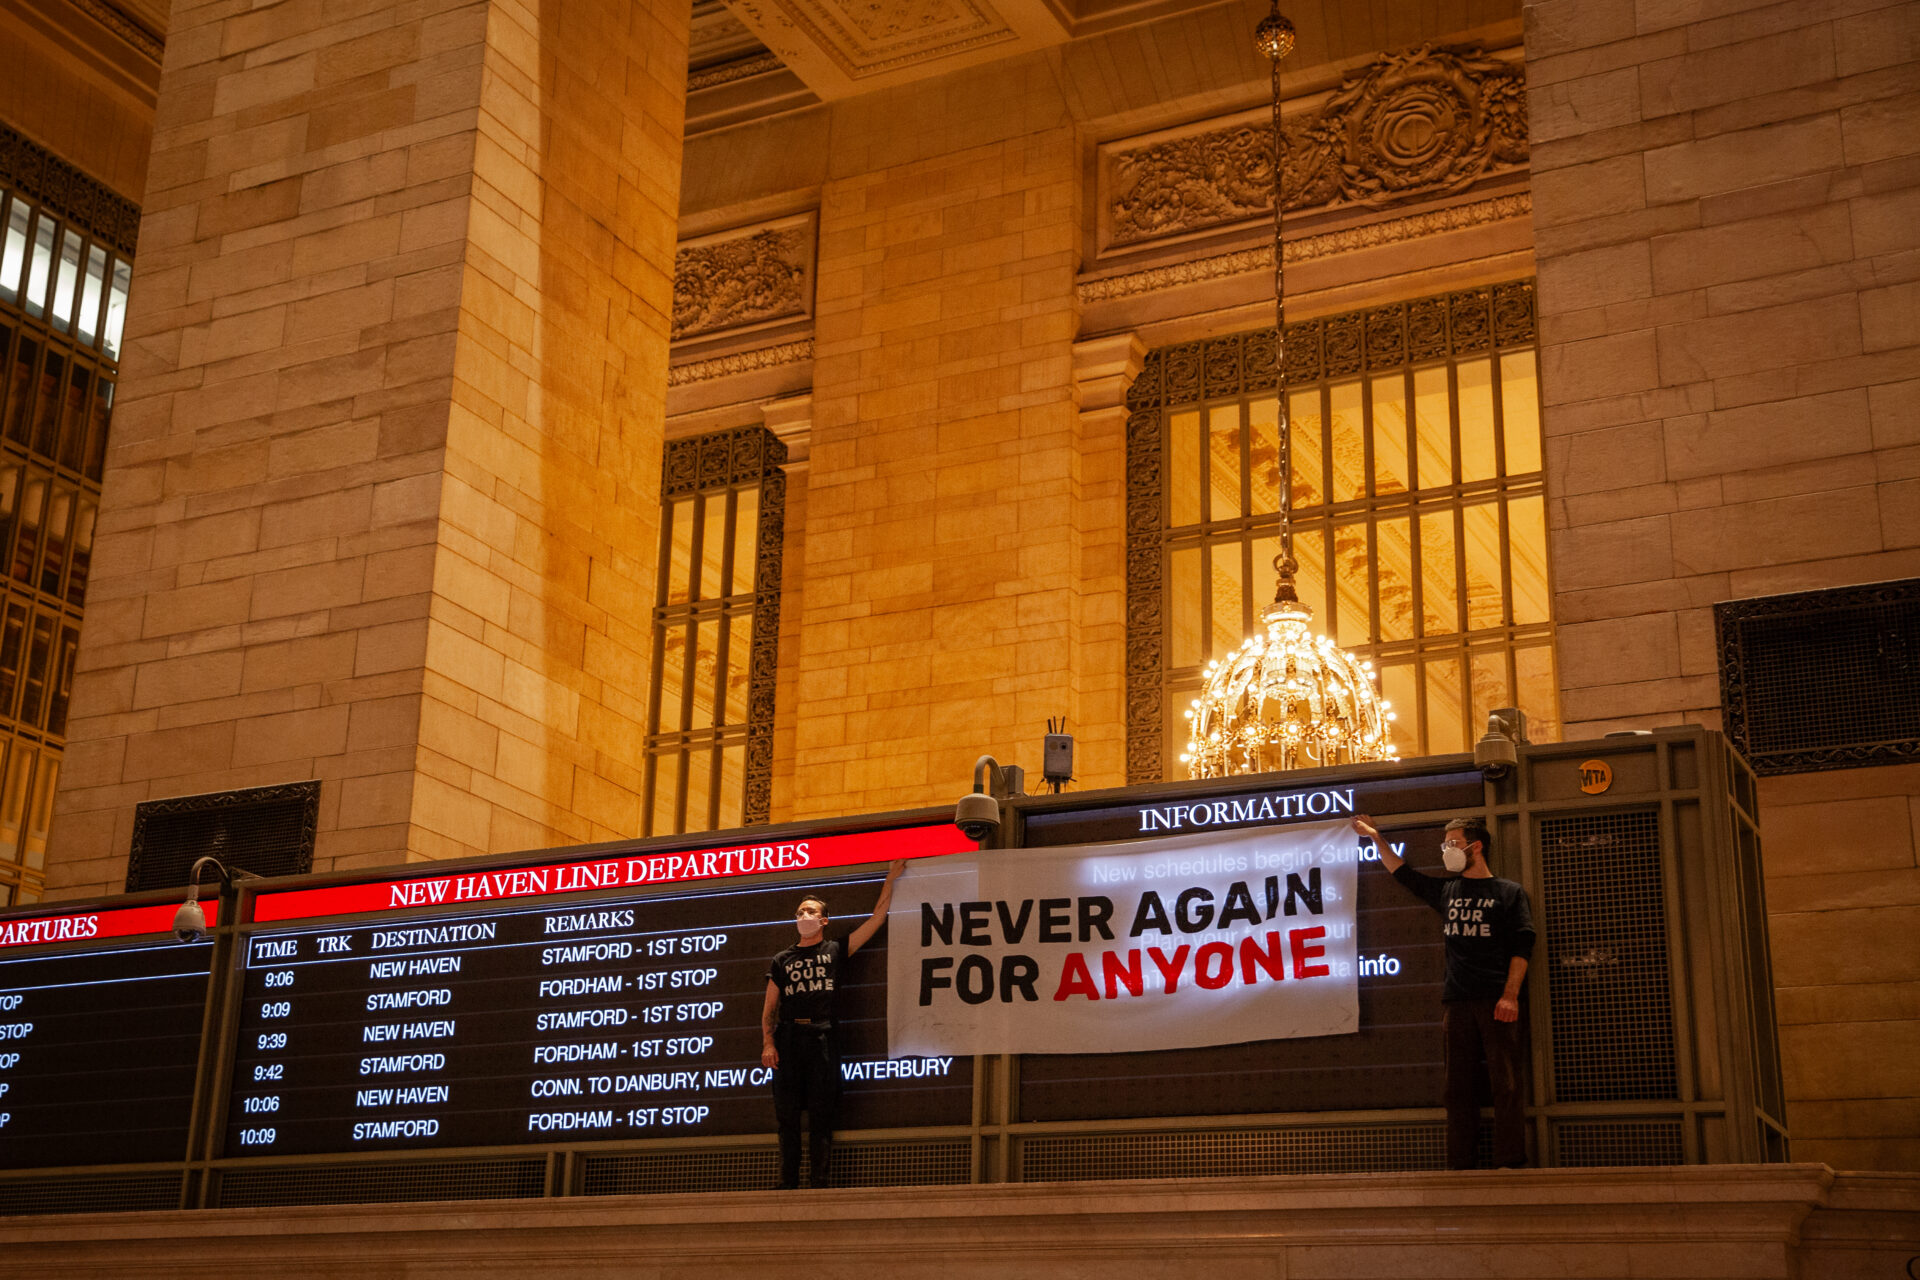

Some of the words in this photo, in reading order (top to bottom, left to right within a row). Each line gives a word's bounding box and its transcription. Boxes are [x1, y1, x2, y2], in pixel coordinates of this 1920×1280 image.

[1138, 788, 1355, 832] INFORMATION
[388, 879, 450, 907] NEW
[454, 869, 550, 900] HAVEN
[554, 862, 620, 891] LINE
[625, 842, 810, 884] DEPARTURES
[1092, 862, 1136, 884] New
[1143, 853, 1248, 880] schedules
[1255, 846, 1313, 873] begin
[1320, 839, 1405, 865] Sundy
[921, 895, 1115, 948] NEVER
[1129, 867, 1325, 938] AGAIN
[1448, 907, 1483, 922] OUR
[1476, 898, 1495, 908] IN
[0, 915, 98, 945] ARTURES
[255, 939, 298, 959] TIME
[316, 935, 353, 953] TRK
[370, 922, 497, 950] DESTINATION
[543, 909, 635, 934] REMARKS
[1443, 921, 1491, 937] NAME
[265, 970, 295, 988] 9:06
[369, 960, 407, 979] NEW
[408, 956, 462, 976] HAVEN
[541, 942, 633, 965] STAMFORD
[646, 937, 678, 956] 1ST
[680, 933, 728, 954] STOP
[785, 958, 813, 974] NOT
[816, 953, 832, 964] IN
[790, 966, 826, 982] OUR
[919, 955, 1040, 1006] FOR
[1053, 926, 1330, 1001] ANYONE
[261, 1001, 291, 1019] 9:09
[366, 988, 452, 1011] STAMFORD
[539, 975, 623, 997] FORDHAM
[636, 971, 668, 990] 1ST
[670, 968, 718, 988] STOP
[784, 978, 834, 996] NAME
[258, 1032, 287, 1050] 9:39
[363, 1024, 401, 1042] NEW
[402, 1020, 456, 1040] HAVEN
[536, 1008, 628, 1031] STAMFORD
[642, 1004, 674, 1023] 1ST
[676, 1001, 724, 1021] STOP
[254, 1064, 284, 1081] 9:42
[359, 1053, 445, 1075] STAMFORD
[534, 1042, 618, 1064] FORDHAM
[632, 1039, 664, 1058] 1ST
[665, 1036, 714, 1056] STOP
[244, 1095, 280, 1113] 10:06
[356, 1088, 394, 1107] NEW
[395, 1085, 449, 1105] HAVEN
[531, 1077, 584, 1097] CONN.
[587, 1076, 612, 1094] TO
[615, 1071, 700, 1093] DANBURY,
[704, 1068, 747, 1088] NEW
[240, 1128, 276, 1145] 10:09
[352, 1119, 439, 1140] STAMFORD
[528, 1110, 613, 1131] FORDHAM
[627, 1108, 659, 1127] 1ST
[661, 1105, 710, 1125] STOP
